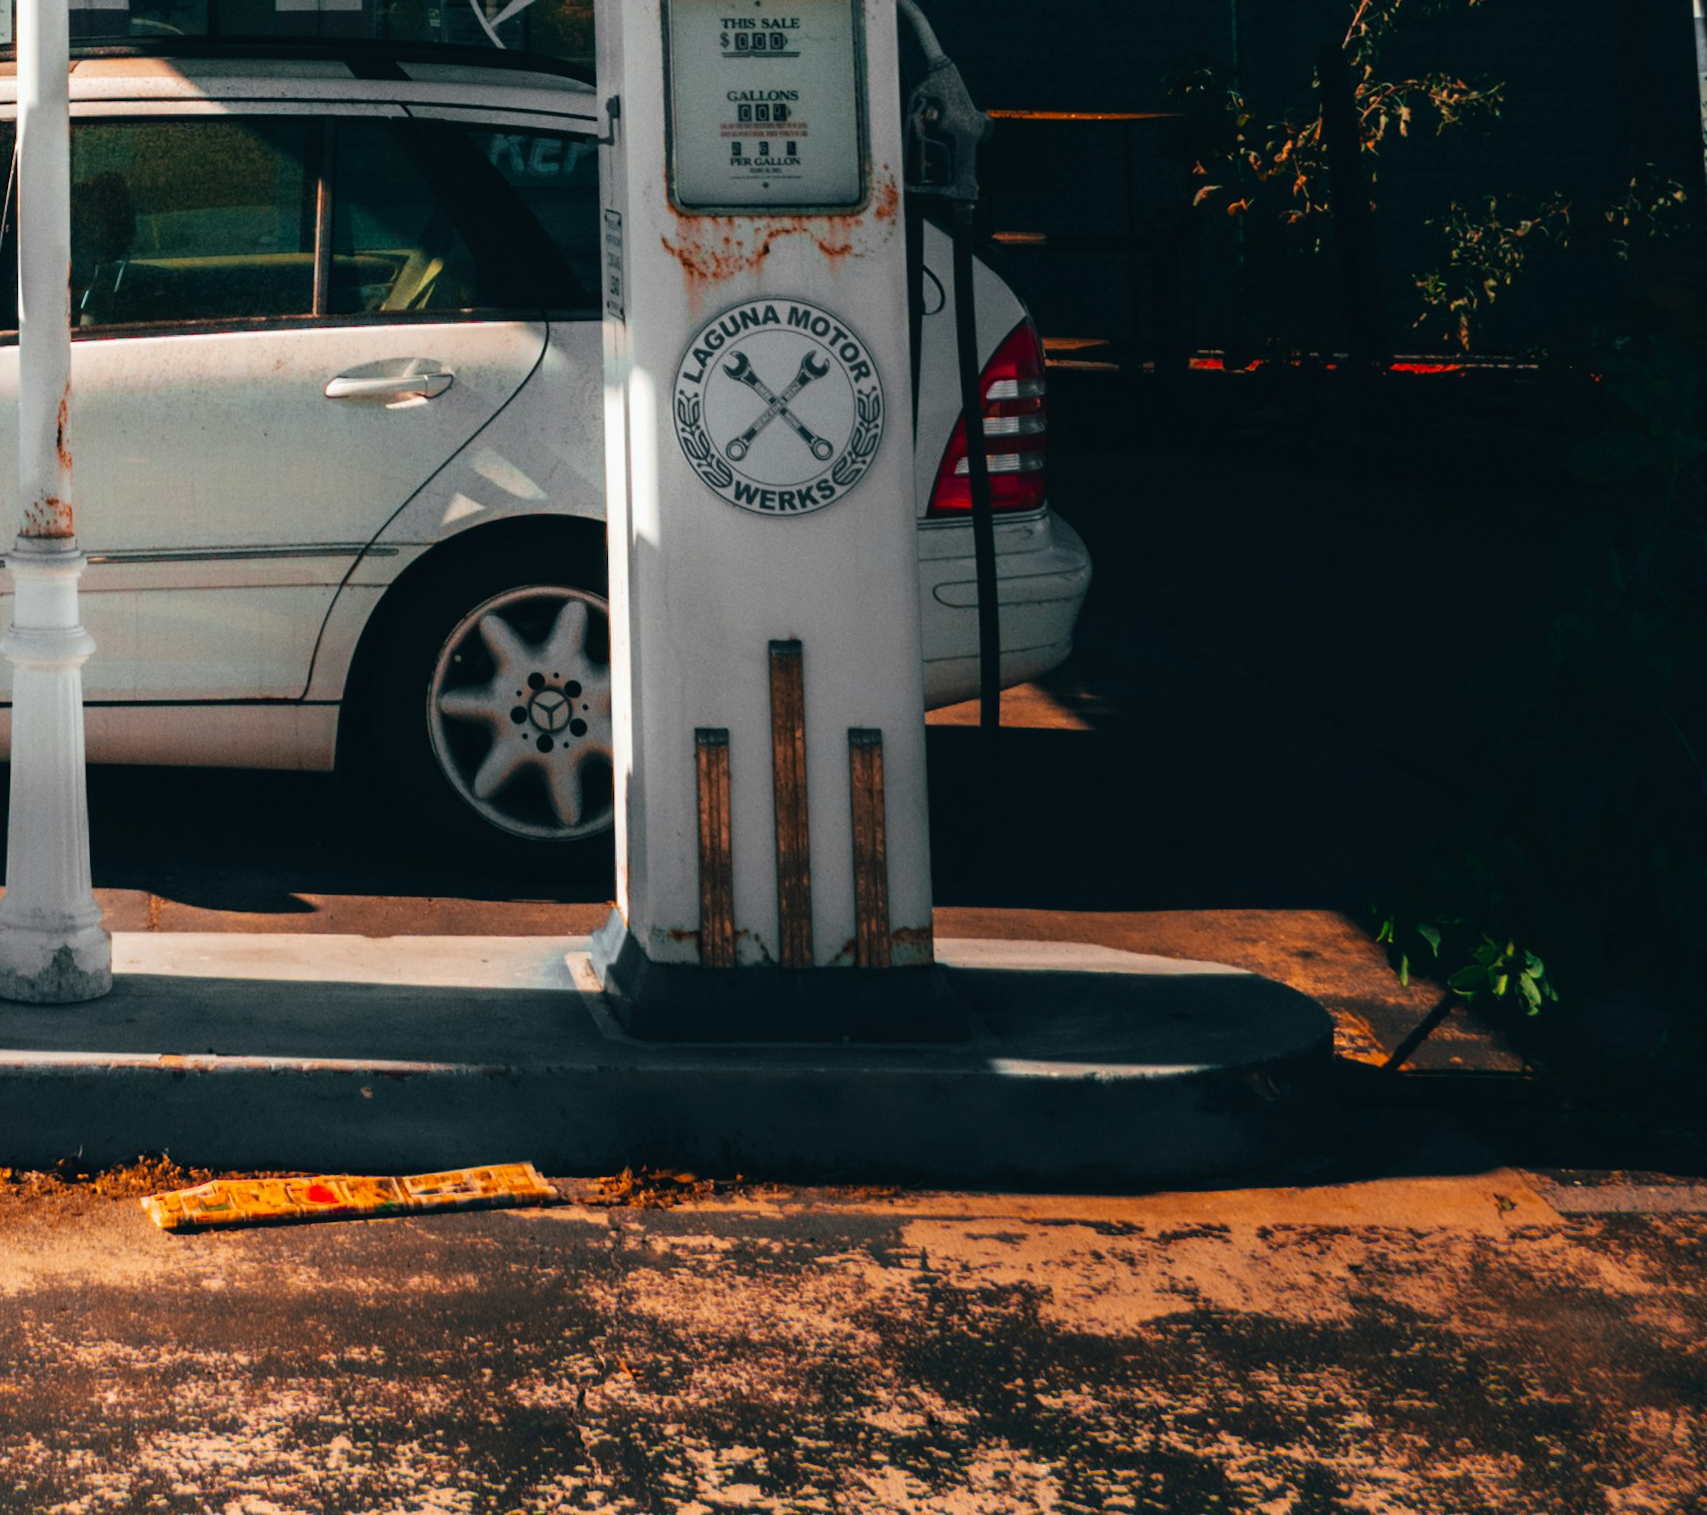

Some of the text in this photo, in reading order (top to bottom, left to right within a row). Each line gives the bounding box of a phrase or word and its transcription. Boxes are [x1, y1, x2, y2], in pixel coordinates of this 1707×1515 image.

[721, 18, 801, 29] THIS SALE
[726, 90, 799, 102] GALLONS
[754, 157, 801, 166] GALLON
[682, 305, 872, 385] LAGUNA MOTOR
[733, 478, 836, 511] WERKS
